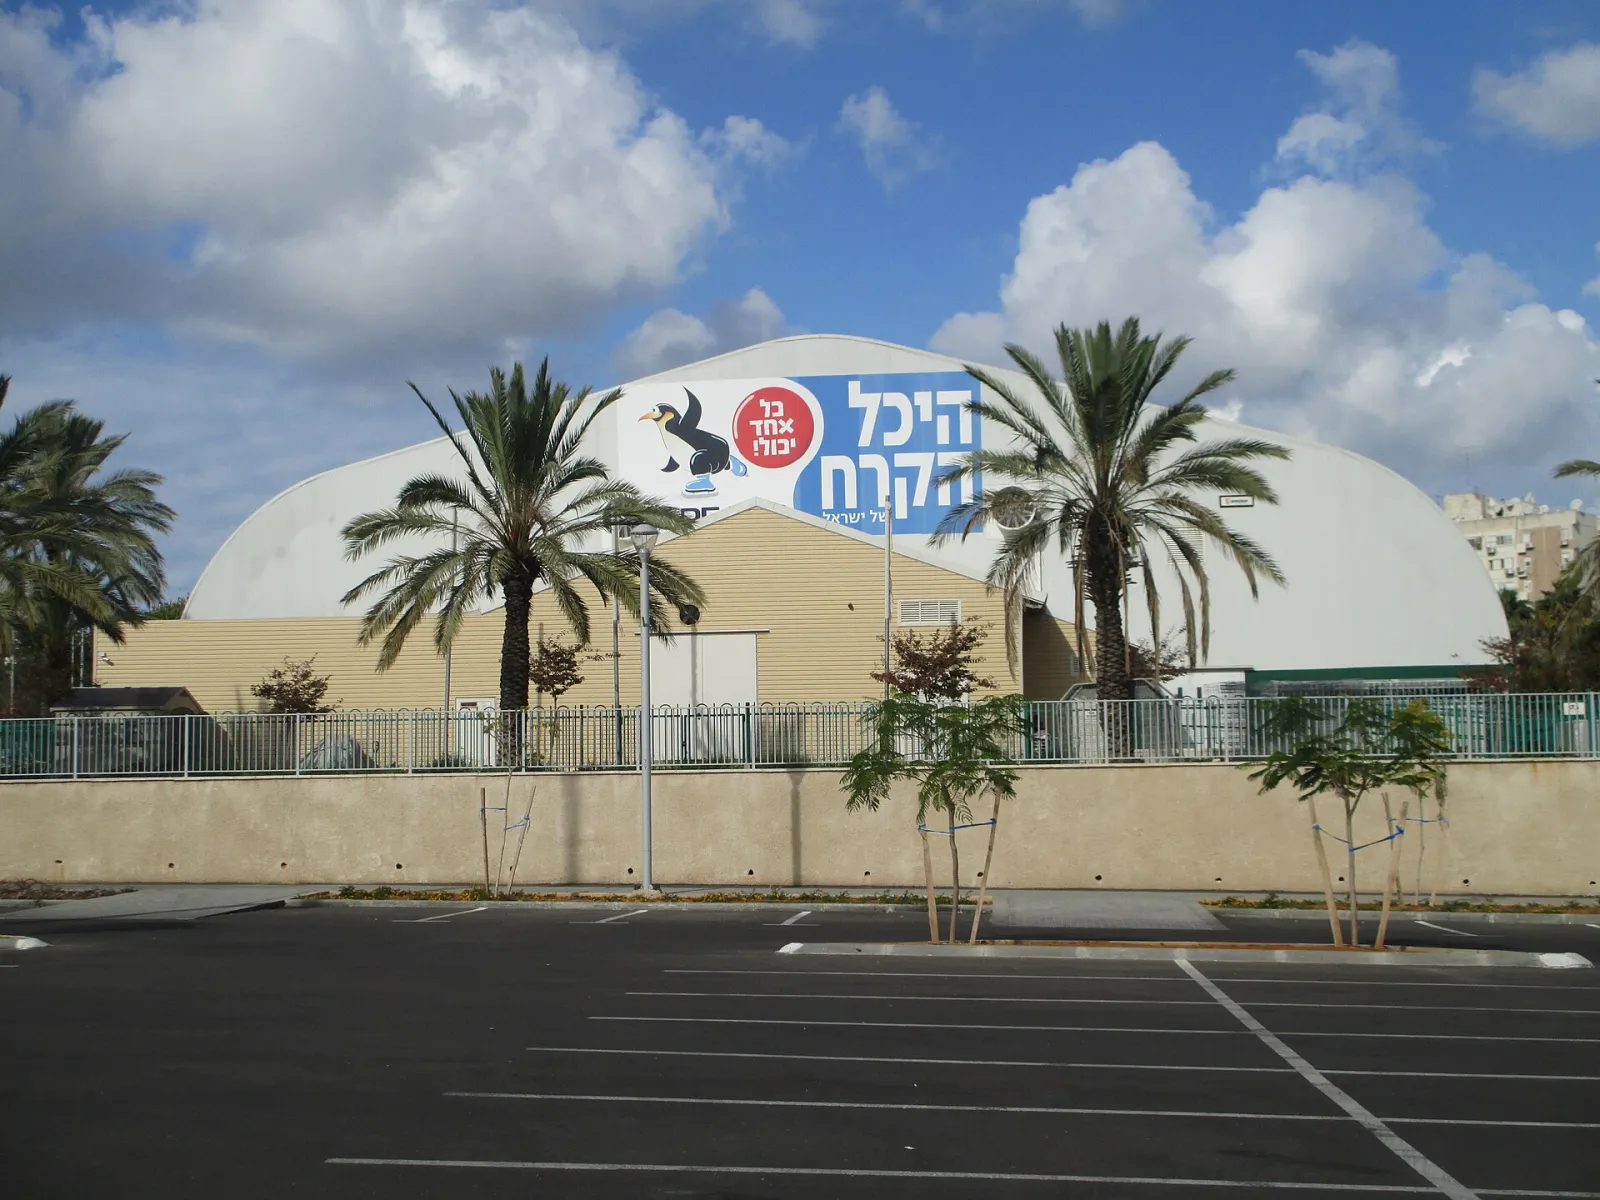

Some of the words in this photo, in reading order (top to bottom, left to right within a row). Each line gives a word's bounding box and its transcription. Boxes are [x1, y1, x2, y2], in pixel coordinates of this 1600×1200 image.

[759, 398, 784, 418] כל
[848, 380, 973, 447] היכל
[749, 417, 794, 436] אחד
[753, 437, 796, 457] יכול!
[820, 451, 974, 519] הקרח
[822, 511, 865, 524] ישראל
